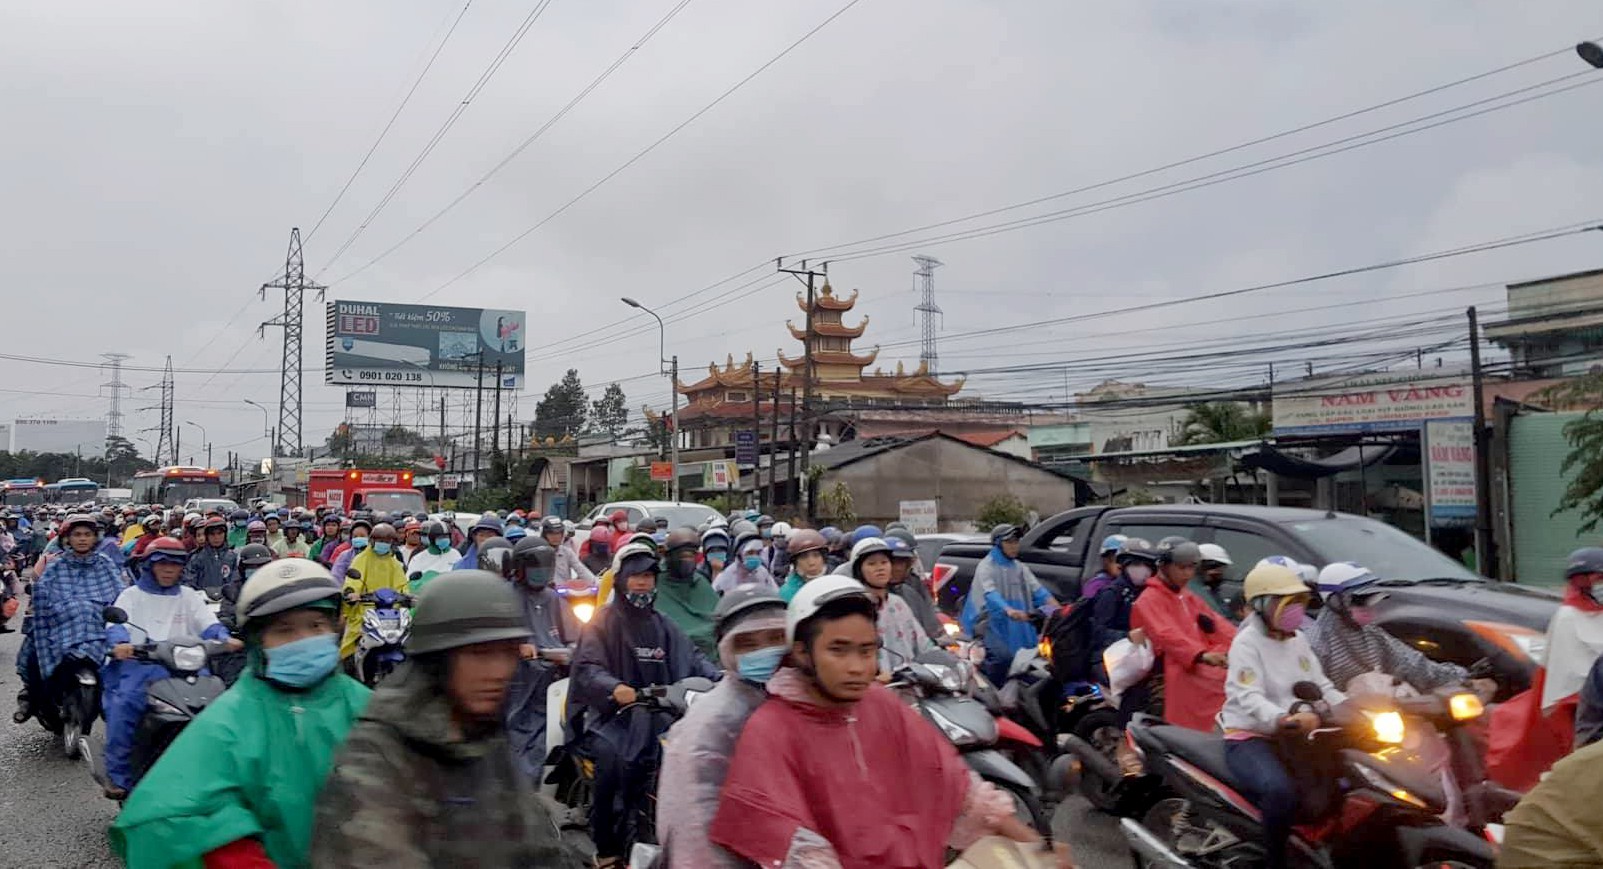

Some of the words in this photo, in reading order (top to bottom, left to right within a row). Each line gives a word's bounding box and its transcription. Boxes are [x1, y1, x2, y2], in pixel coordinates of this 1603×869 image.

[340, 304, 380, 315] DUHAL
[341, 316, 378, 333] LED
[360, 371, 382, 380] 0901
[385, 372, 402, 381] 020
[406, 373, 422, 381] 138
[353, 393, 374, 401] CMN
